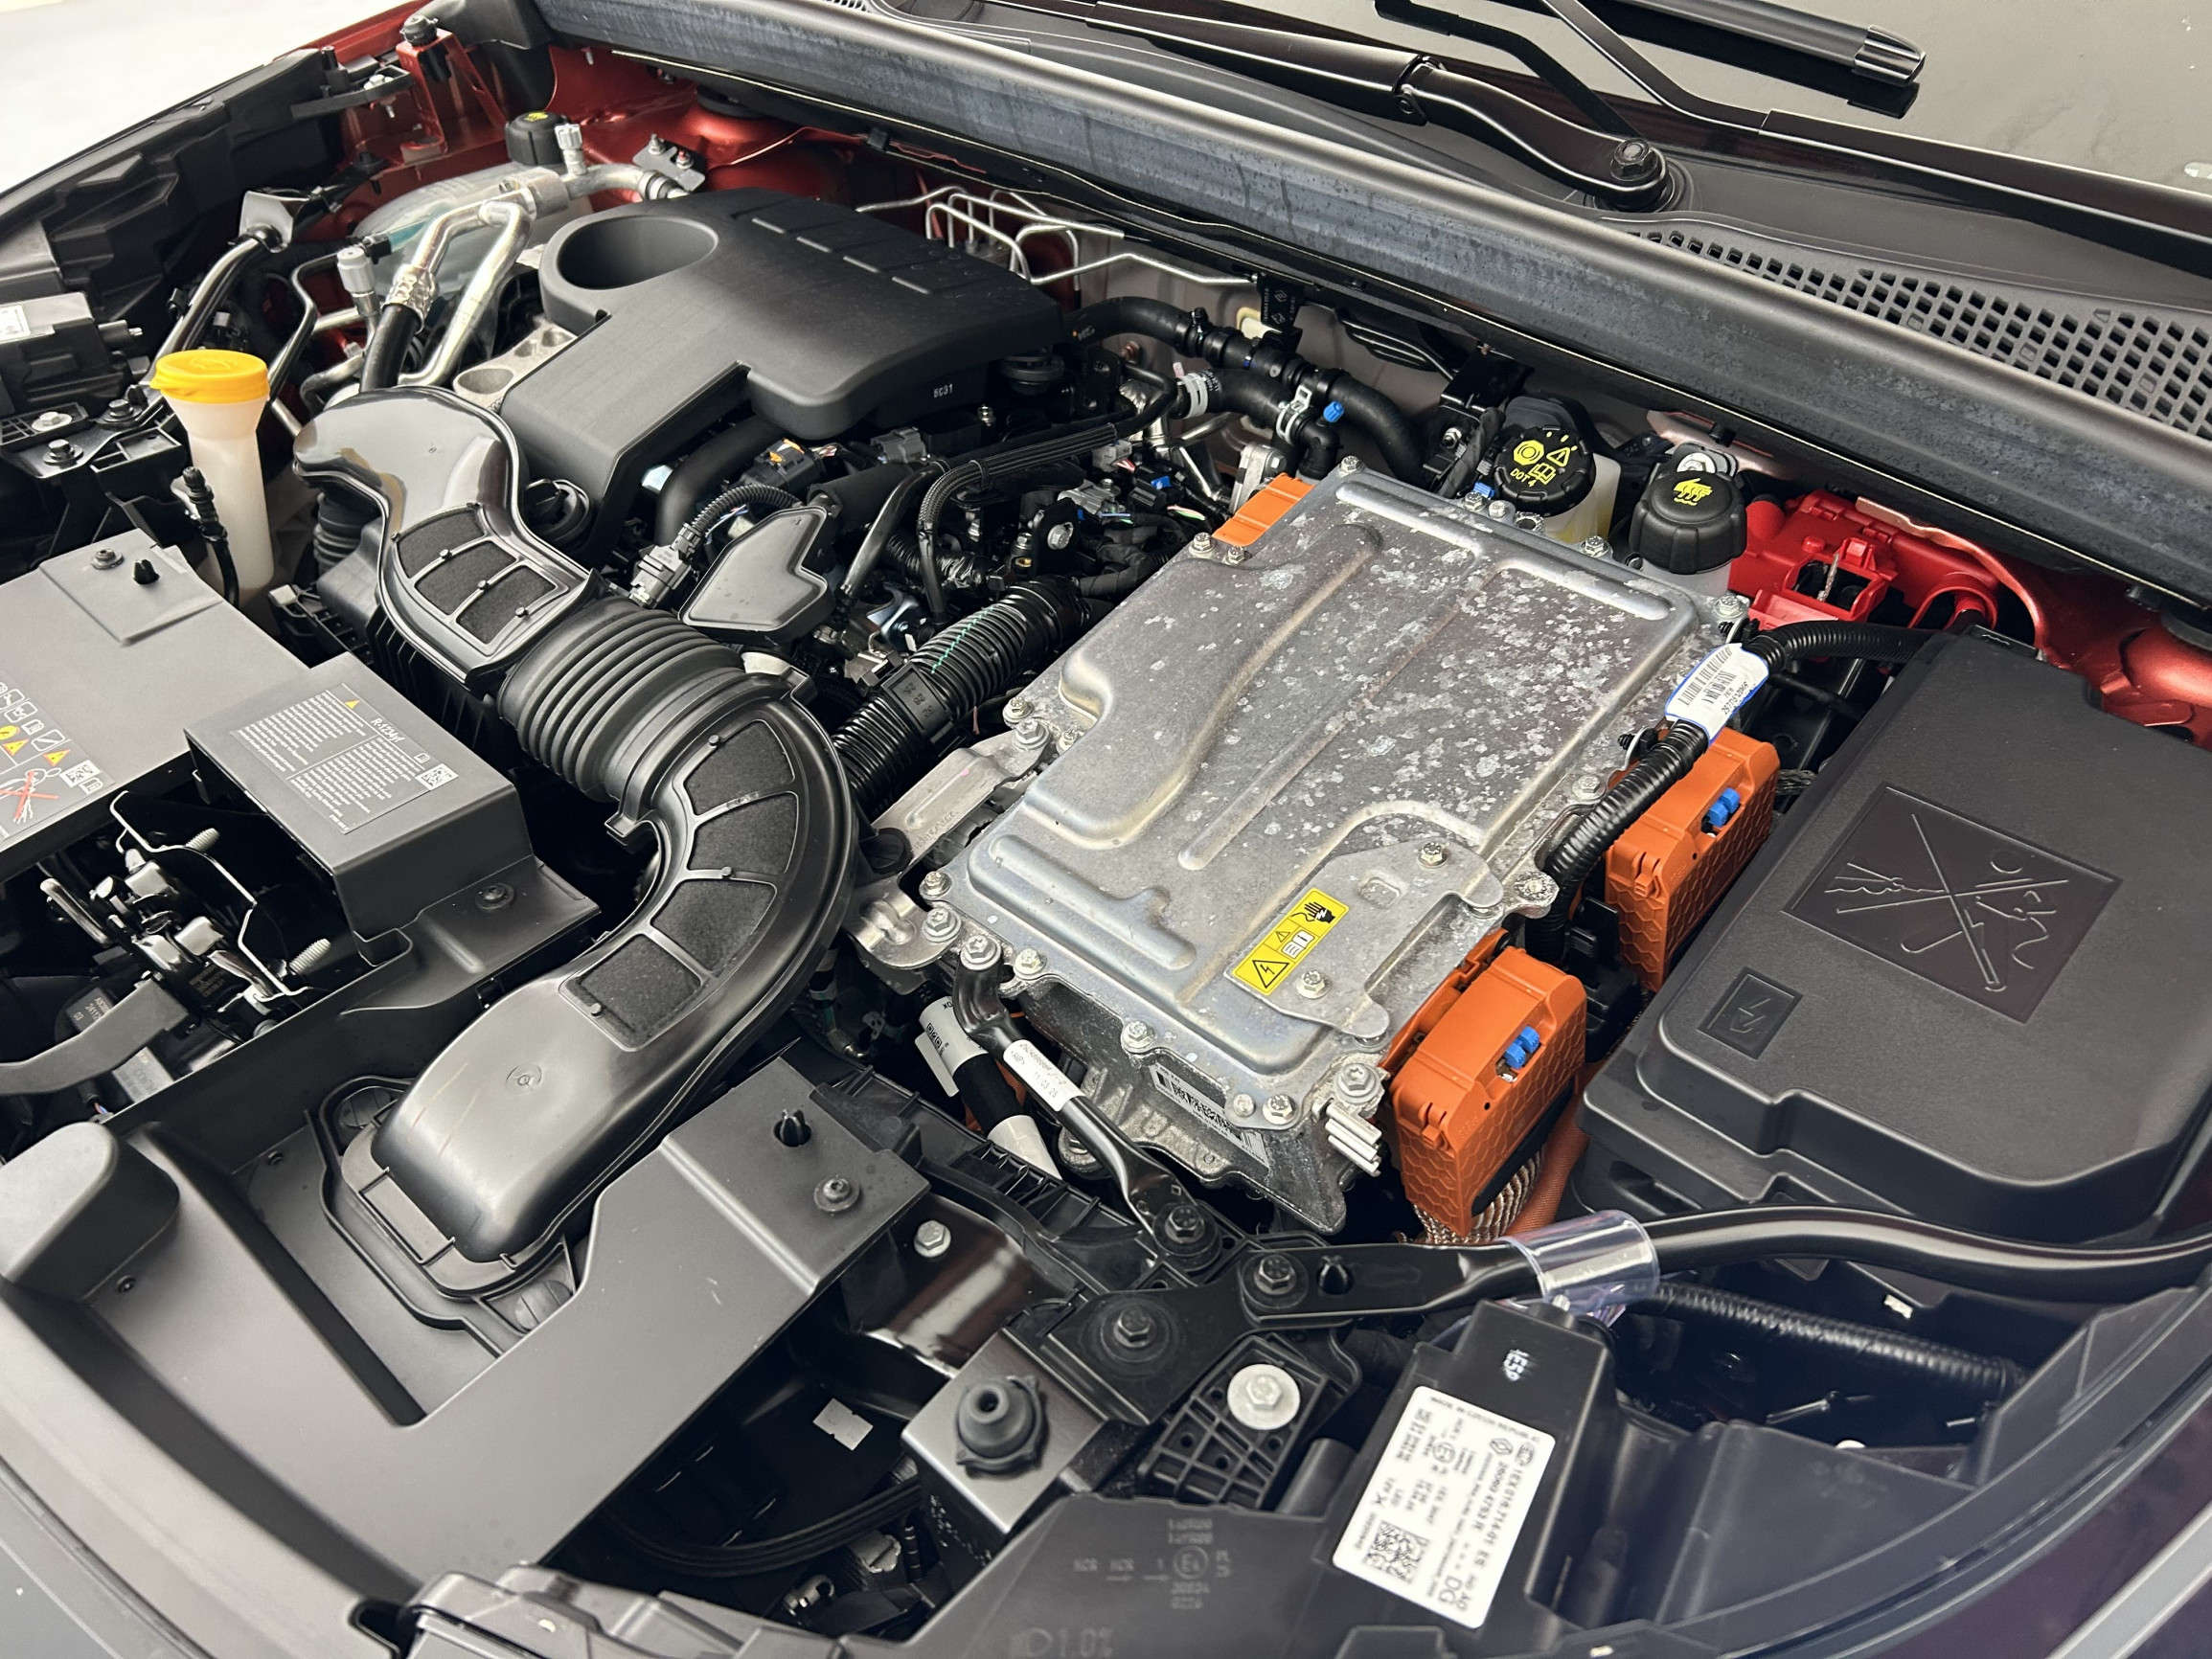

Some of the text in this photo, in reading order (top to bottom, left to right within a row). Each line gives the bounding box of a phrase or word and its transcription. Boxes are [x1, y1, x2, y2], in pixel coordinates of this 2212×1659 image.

[1510, 468, 1537, 488] DOT 4
[371, 717, 406, 743] R-1234yf
